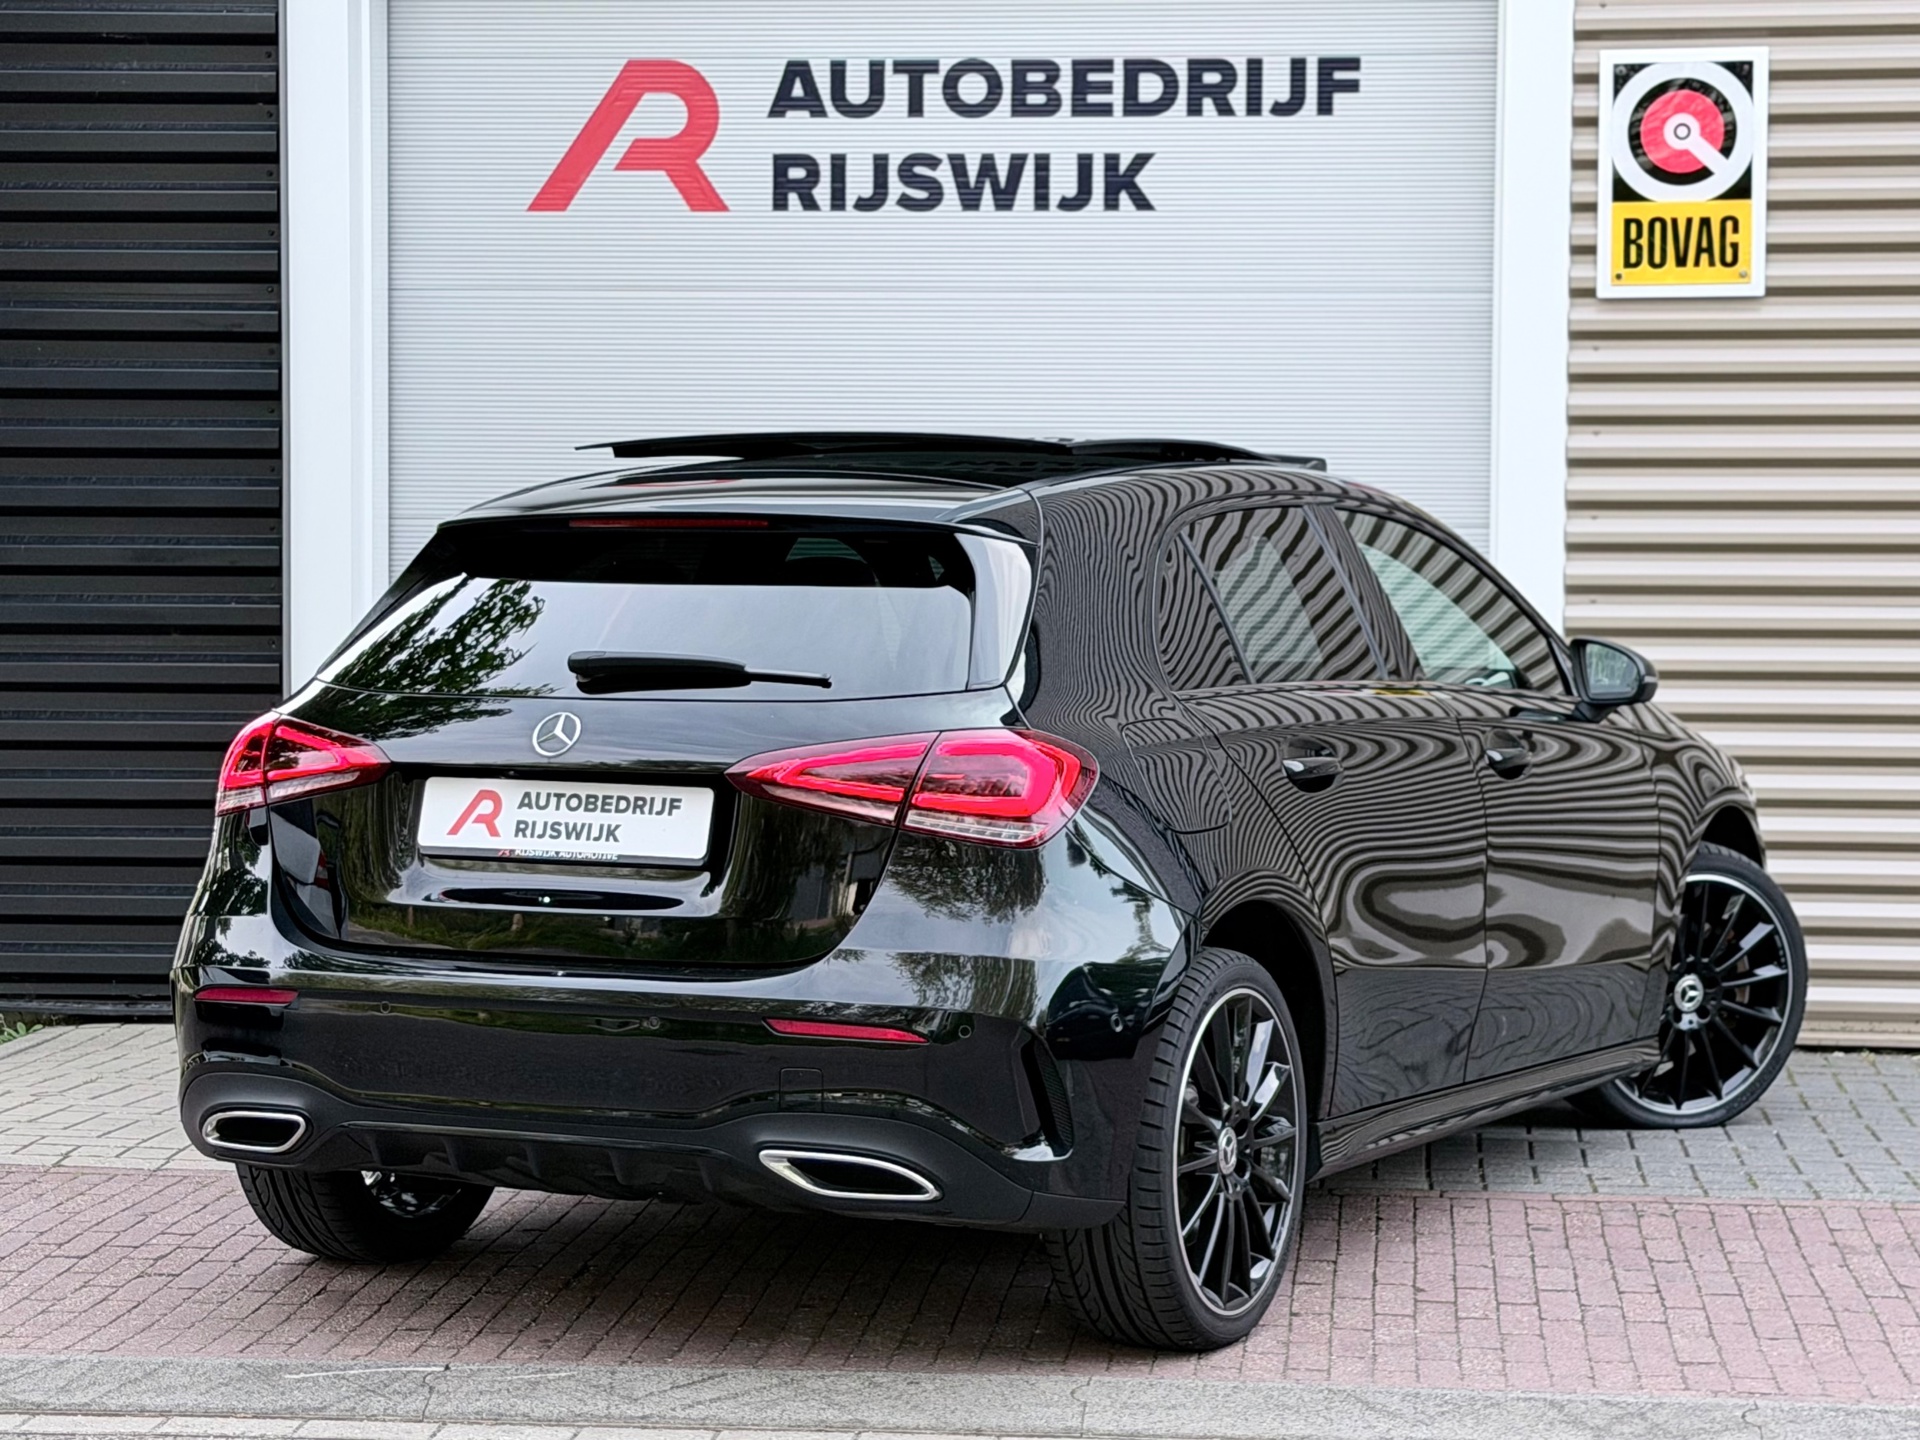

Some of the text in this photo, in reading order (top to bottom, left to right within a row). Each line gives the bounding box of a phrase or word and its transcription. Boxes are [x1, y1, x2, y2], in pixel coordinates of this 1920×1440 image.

[768, 57, 1361, 118] AUTOBEDRIJF
[772, 152, 1156, 212] RIJSWIJK
[1622, 215, 1740, 270] BOVAG
[514, 819, 622, 842] RIJSWIJK
[516, 791, 683, 816] AUTOBEDRIJF
